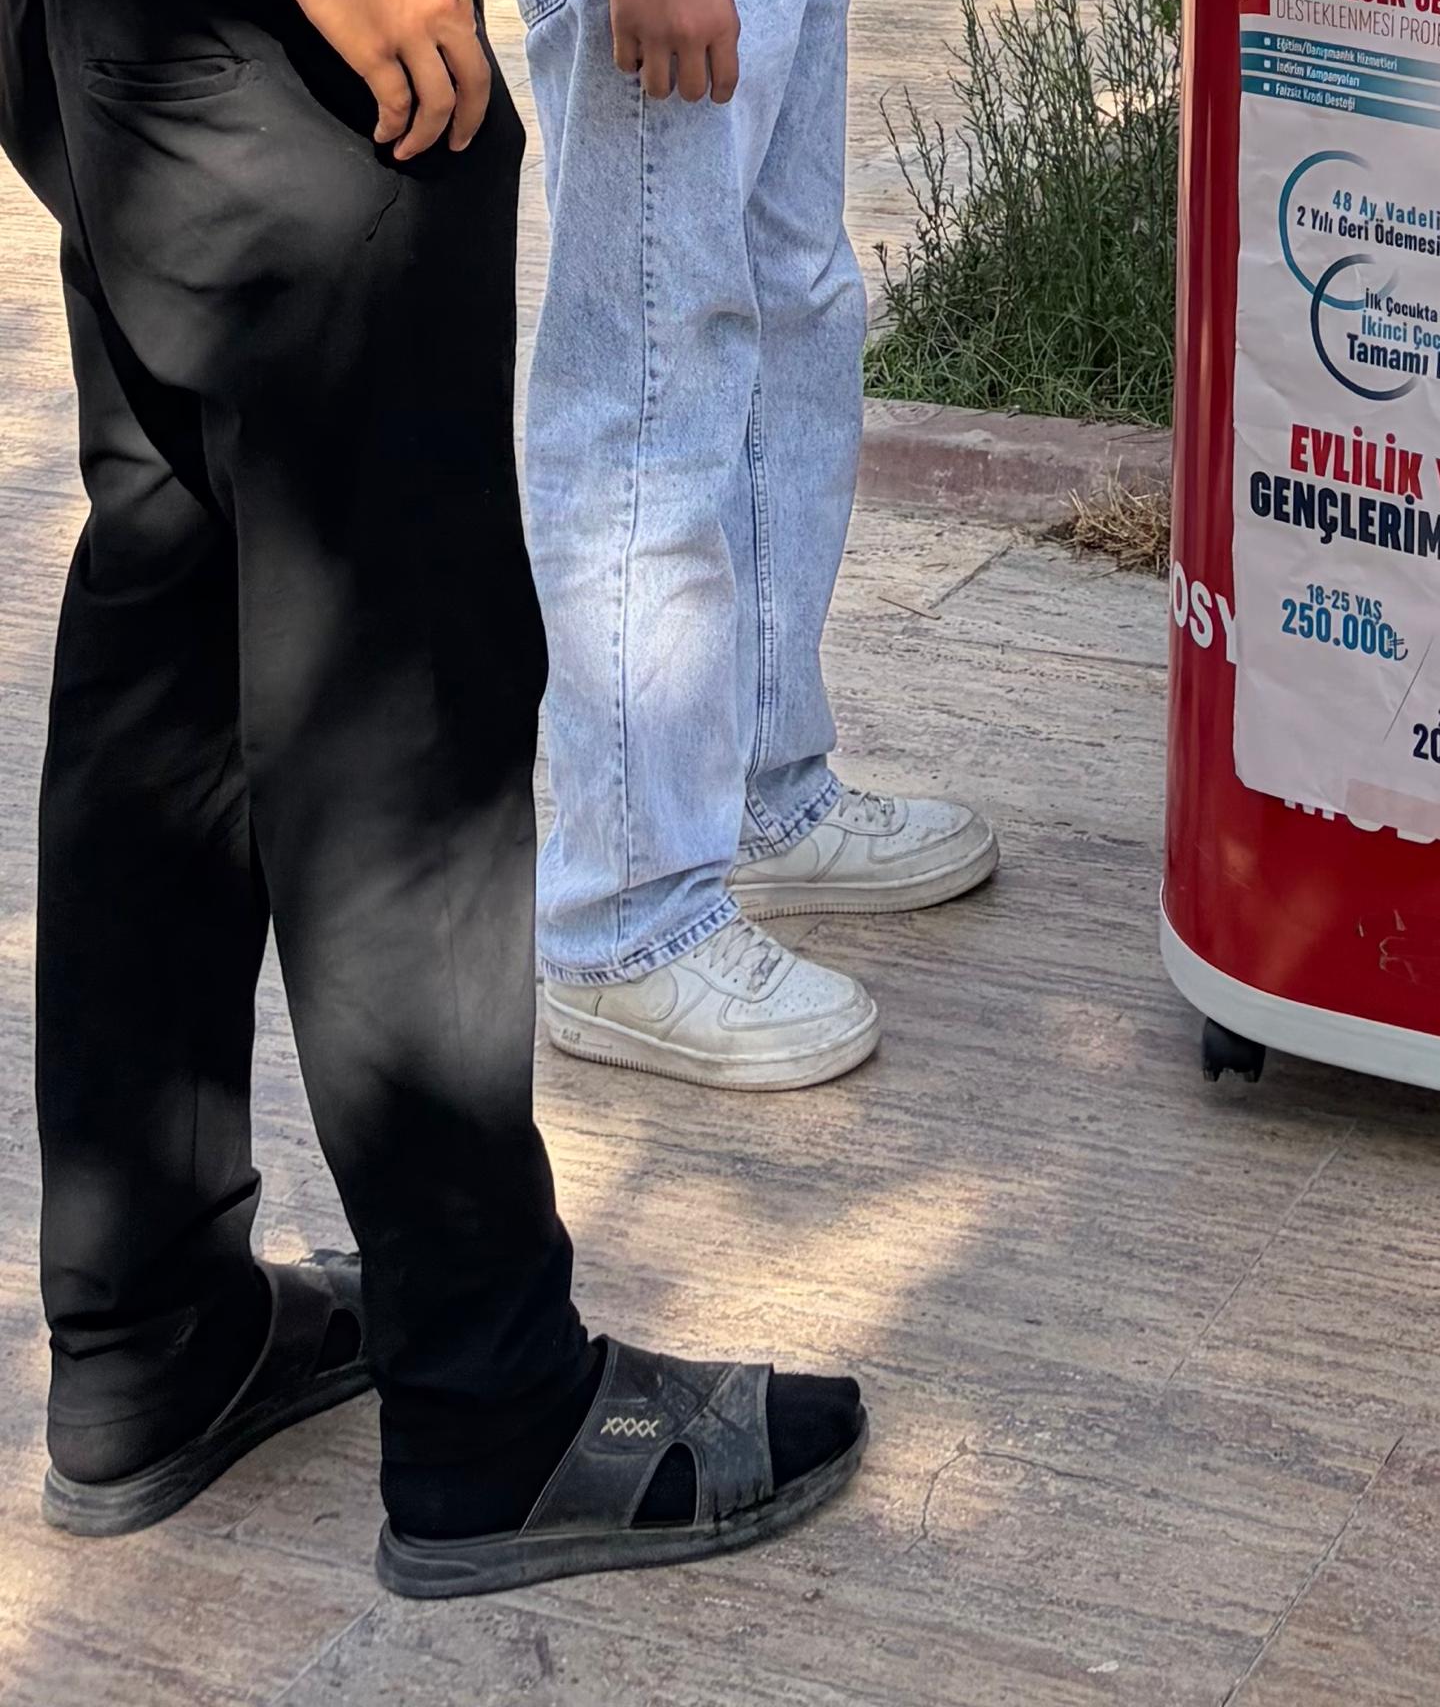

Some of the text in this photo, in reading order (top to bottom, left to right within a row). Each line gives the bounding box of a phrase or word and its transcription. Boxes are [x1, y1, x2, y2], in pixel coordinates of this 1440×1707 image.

[1296, 205, 1305, 227] 2
[1310, 207, 1333, 235] Yılı
[1338, 215, 1369, 242] Geri
[1332, 189, 1440, 231] 48 Ay Vadeli
[1361, 309, 1408, 343] İkinci
[1364, 287, 1382, 311] İlk
[1386, 296, 1438, 324] Çocukta
[1346, 331, 1430, 377] Tamamı
[1289, 422, 1424, 501] EVLİLİK
[1306, 583, 1383, 625] 18-25 YAŞ
